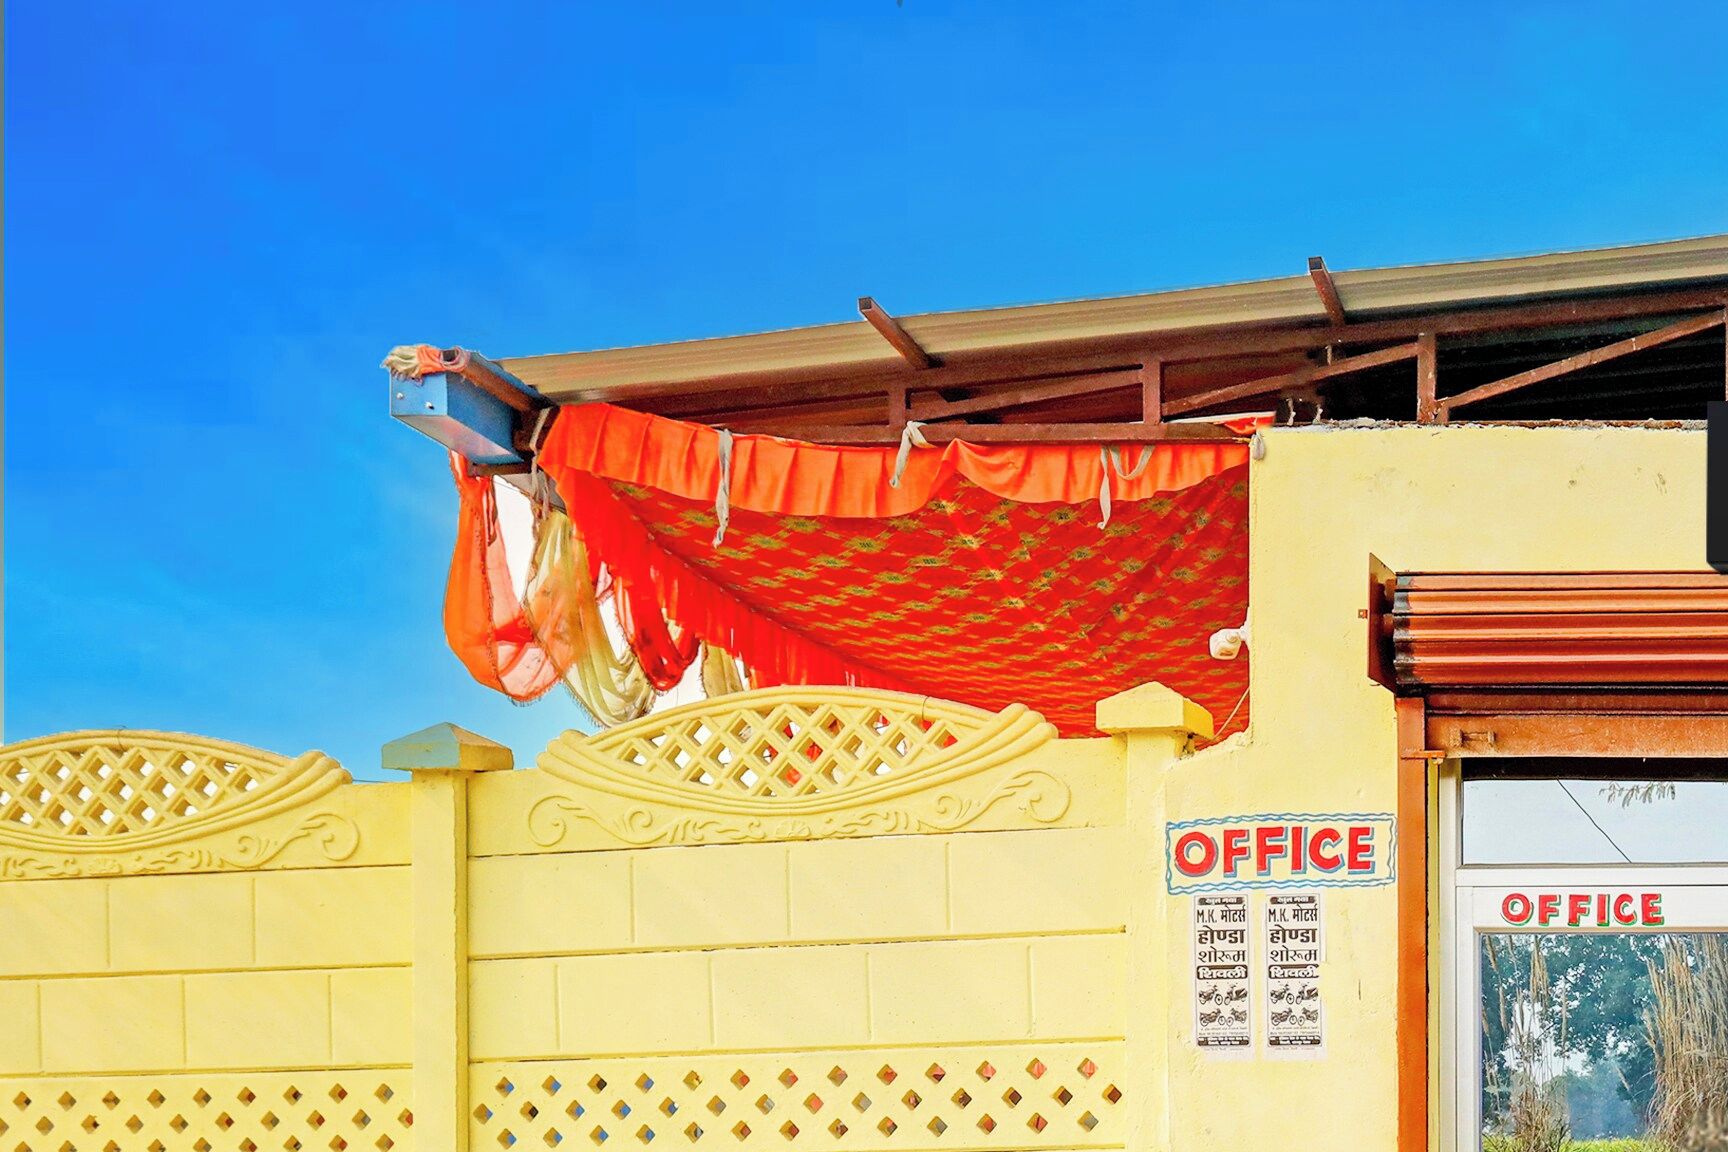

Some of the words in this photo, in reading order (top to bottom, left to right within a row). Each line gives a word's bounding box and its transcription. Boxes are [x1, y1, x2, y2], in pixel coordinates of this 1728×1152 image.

[1174, 826, 1375, 878] OFFICE
[1196, 909, 1217, 923] M.K.
[1220, 904, 1246, 923] मोटर्स
[1268, 908, 1289, 922] M.K.
[1292, 903, 1318, 922] मोटर्स
[1500, 892, 1665, 927] OFFICE
[1197, 925, 1246, 944] होण्डा
[1269, 924, 1318, 943] होण्डा
